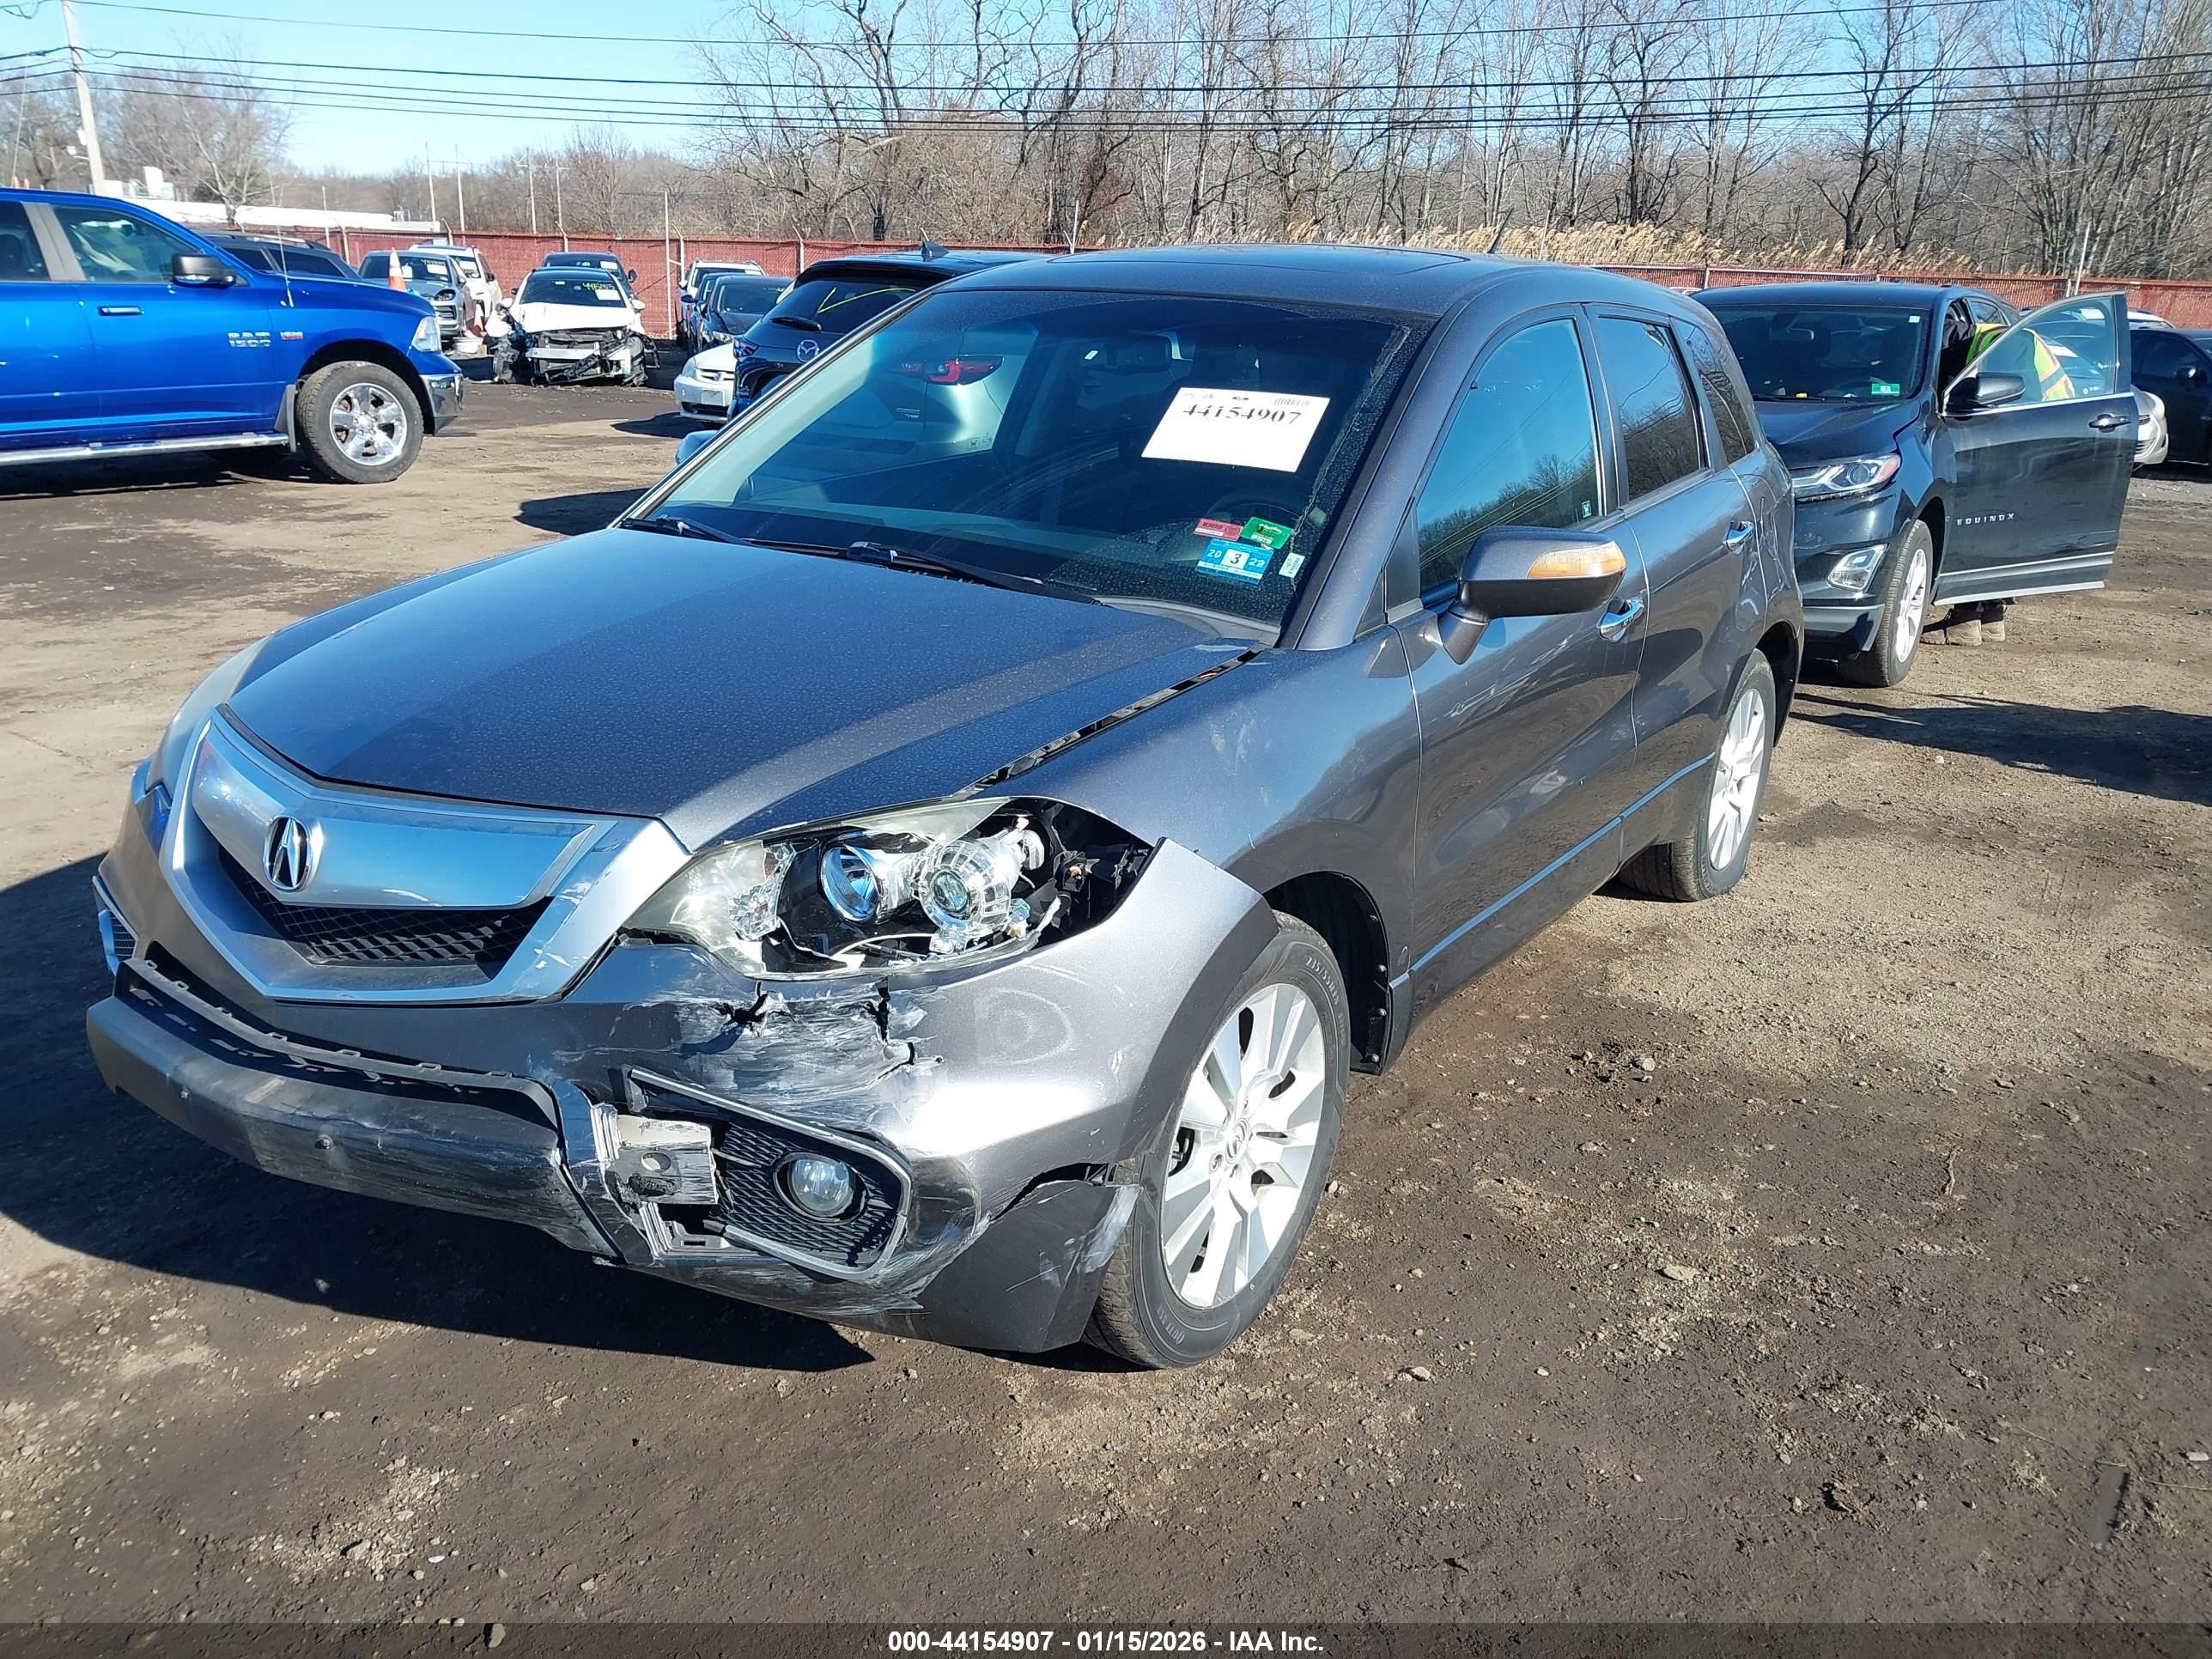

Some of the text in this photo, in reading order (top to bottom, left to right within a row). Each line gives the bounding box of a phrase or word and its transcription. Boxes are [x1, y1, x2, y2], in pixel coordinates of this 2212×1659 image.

[229, 339, 271, 348] 1500
[1182, 404, 1302, 424] 44154907
[1957, 514, 2014, 525] EQUINOX
[1206, 550, 1266, 568] 20 3 22
